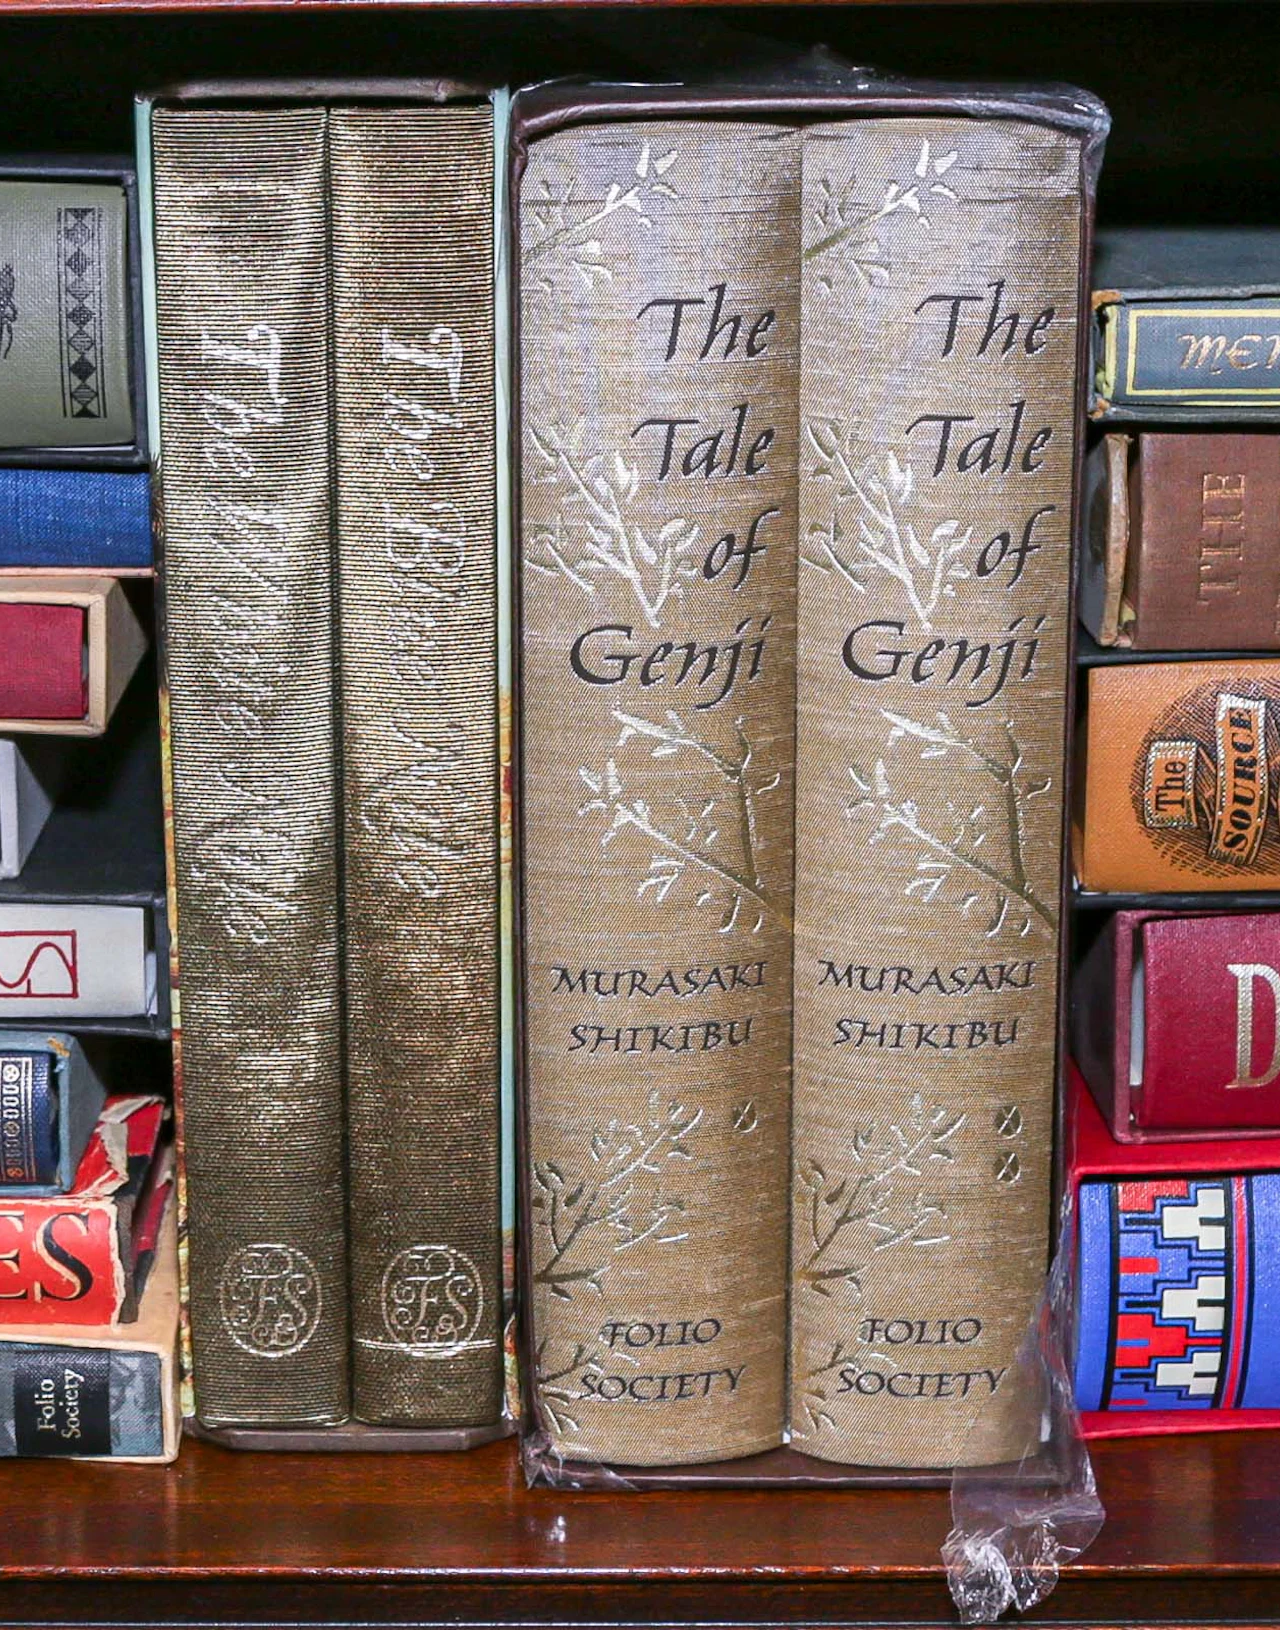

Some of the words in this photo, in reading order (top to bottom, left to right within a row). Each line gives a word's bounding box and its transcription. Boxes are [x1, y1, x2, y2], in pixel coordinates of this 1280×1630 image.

[637, 284, 775, 362] The
[916, 280, 1056, 357] The
[201, 324, 286, 477] The
[380, 326, 466, 481] The
[631, 404, 775, 480] Tale
[905, 401, 1052, 478] Tale
[703, 506, 780, 590] of
[976, 505, 1056, 589] of
[1197, 472, 1245, 607] THE
[381, 500, 470, 684] Blue
[569, 616, 772, 710] Genji
[842, 616, 1044, 708] Genji
[361, 706, 470, 900] Nile
[1154, 757, 1187, 814] The
[1223, 706, 1254, 854] SOURCE
[552, 961, 768, 999] MURASAKI
[819, 960, 1038, 996] MURASAKI
[569, 1017, 753, 1054] SHIKIBU
[834, 1017, 1019, 1049] SHIKIBU
[607, 1317, 721, 1348] FOLIO
[860, 1317, 983, 1346] FOLIO
[36, 1377, 55, 1432] Folio
[62, 1369, 85, 1439] Society
[580, 1364, 746, 1401] SOCIETY
[837, 1366, 1007, 1397] SOCIETY
